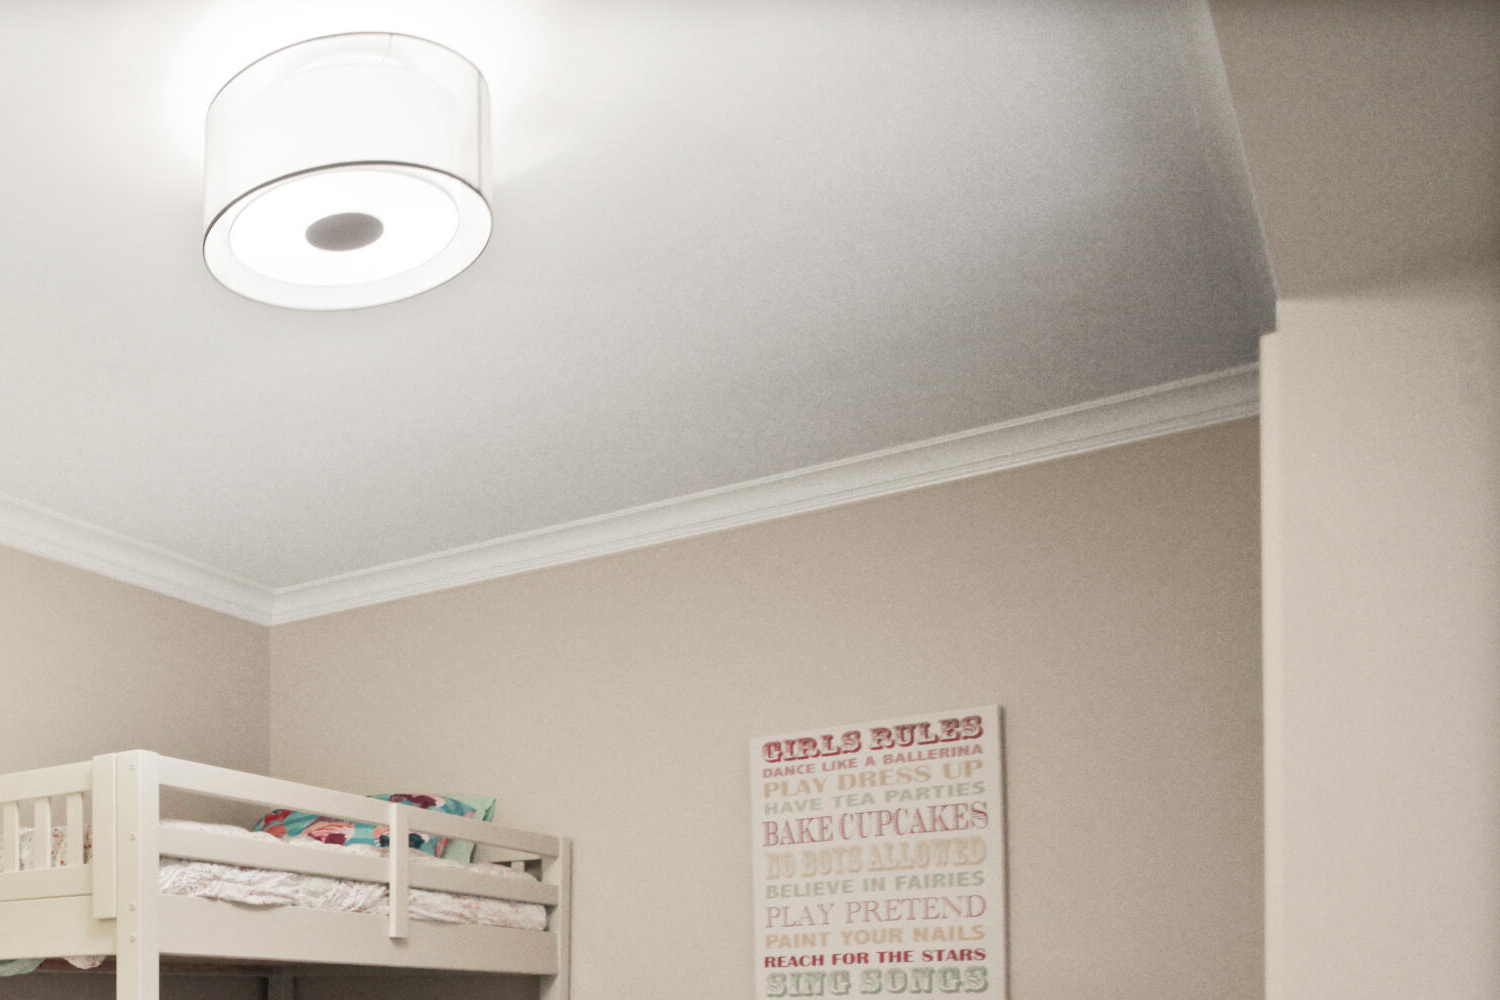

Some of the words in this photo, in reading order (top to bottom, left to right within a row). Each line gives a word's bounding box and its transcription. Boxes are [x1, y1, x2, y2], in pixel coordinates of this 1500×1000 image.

[762, 731, 862, 763] GIRLS
[869, 716, 983, 750] RULES
[762, 763, 815, 778] DANCE
[822, 758, 857, 772] LIKE
[865, 756, 876, 766] A
[884, 744, 983, 764] BALLERINA
[764, 777, 827, 799] PLAY
[838, 764, 931, 791] DRESS
[943, 760, 983, 780] UP
[764, 798, 822, 815] HAVE
[832, 793, 874, 809] TEA
[885, 781, 985, 803] PARTIES
[763, 816, 833, 847] BAKE
[840, 801, 989, 840] CUPCAKES
[766, 851, 796, 880] NO
[801, 845, 862, 877] BOYS
[868, 835, 987, 871] ALLOWED
[766, 880, 853, 899] BELIEVE
[863, 877, 885, 892] IN
[895, 871, 985, 890] FAIRIES
[766, 903, 834, 928] PLAY
[846, 895, 986, 924] PRETEND
[765, 932, 830, 949] PAINT
[840, 927, 902, 946] YOUR
[913, 924, 985, 942] NAILS
[764, 955, 824, 968] REACH
[832, 952, 868, 965] FOR
[877, 950, 914, 963] THE
[922, 949, 986, 962] STARS
[766, 970, 851, 998] SING
[860, 966, 989, 994] SONGS
